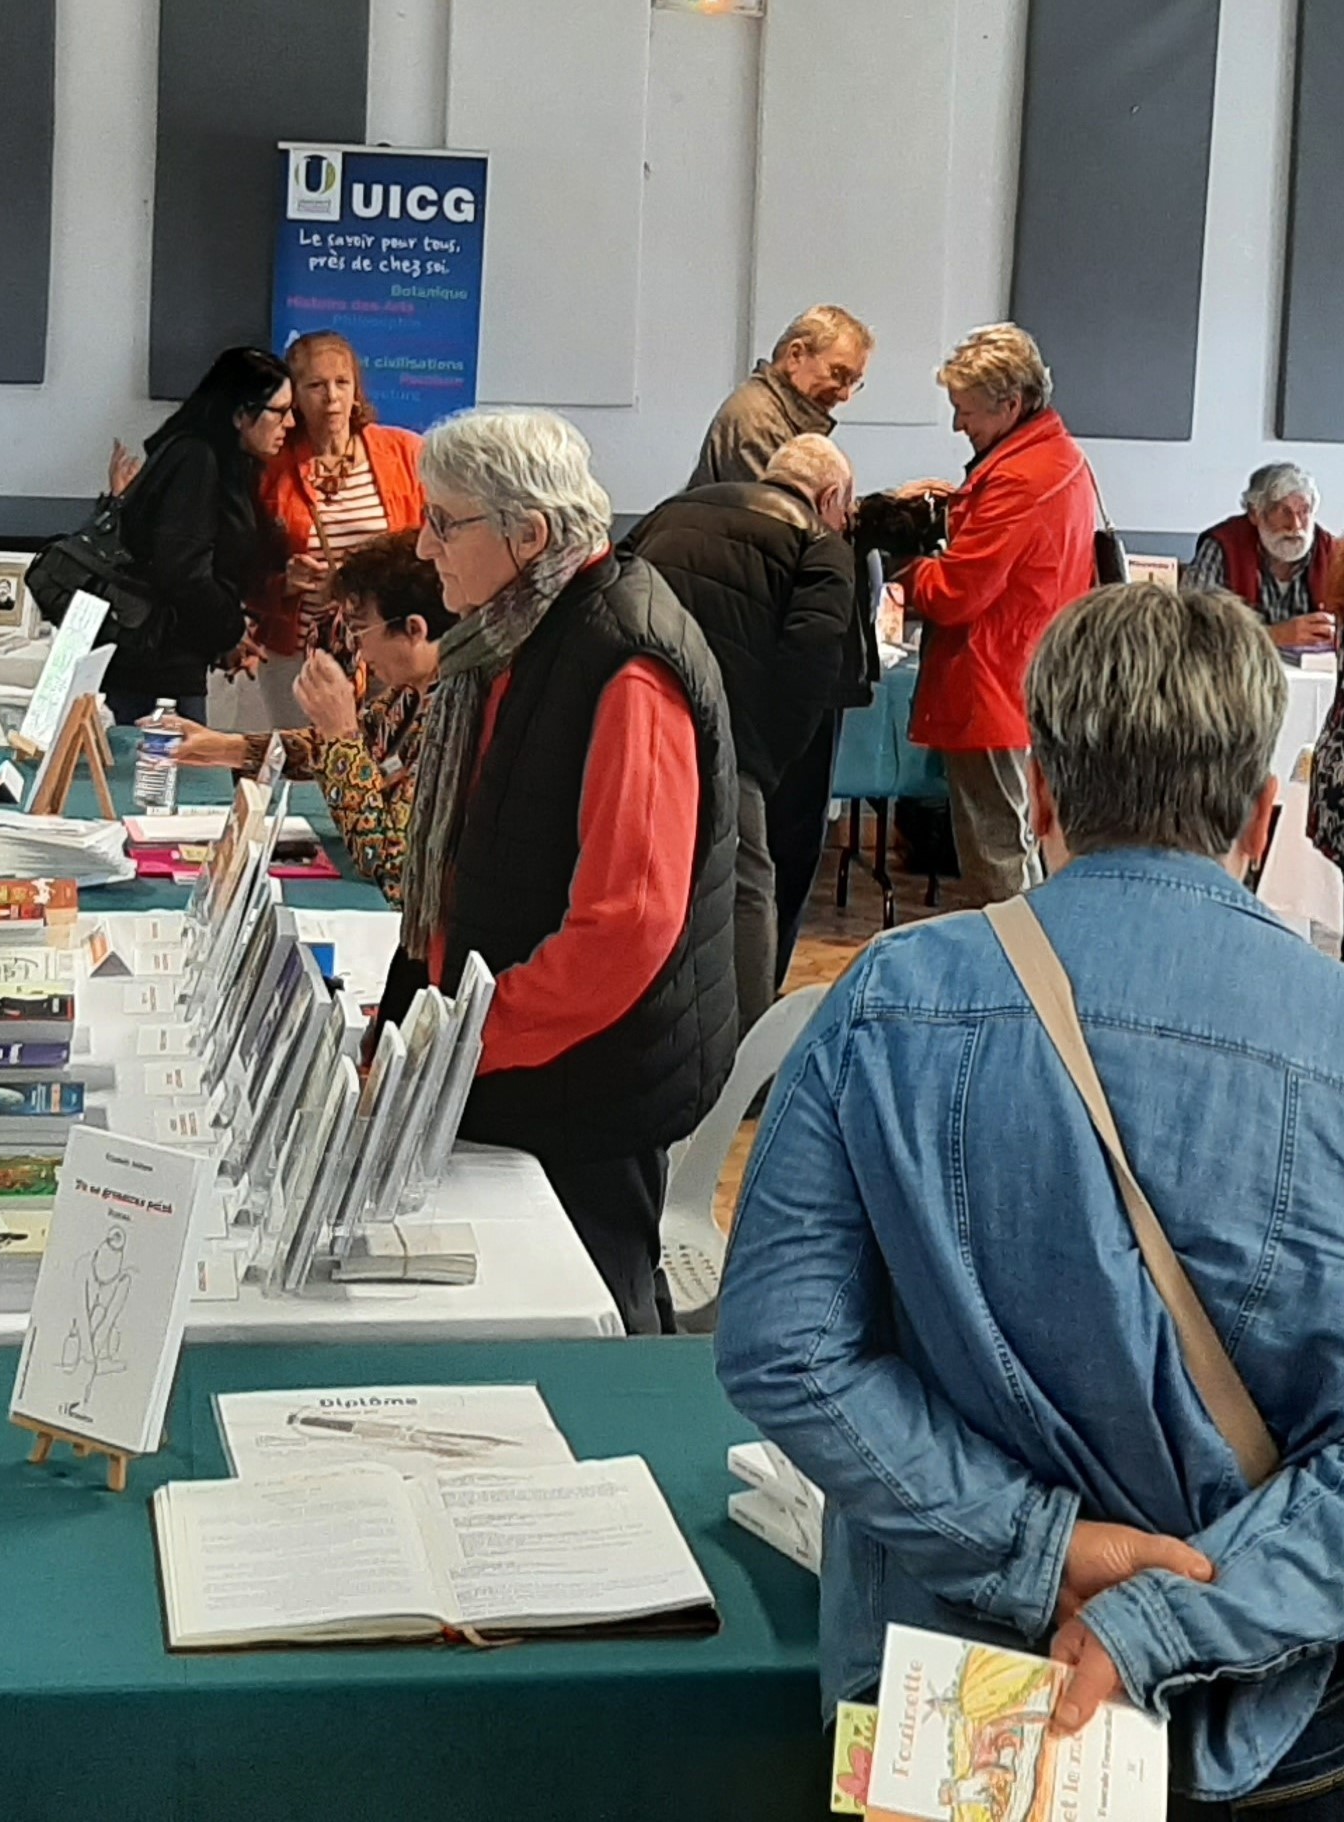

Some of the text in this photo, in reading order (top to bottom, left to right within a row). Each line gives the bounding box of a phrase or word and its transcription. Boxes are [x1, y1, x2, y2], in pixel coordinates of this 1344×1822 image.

[352, 182, 476, 223] UICG
[299, 228, 322, 247] Le
[327, 232, 375, 249] savoir
[381, 238, 417, 255] pour
[309, 251, 346, 272] près
[352, 255, 373, 271] de
[379, 255, 421, 278] chez
[391, 284, 468, 302] Botanique
[374, 357, 465, 371] civilisations
[319, 1395, 419, 1409] Diplôme
